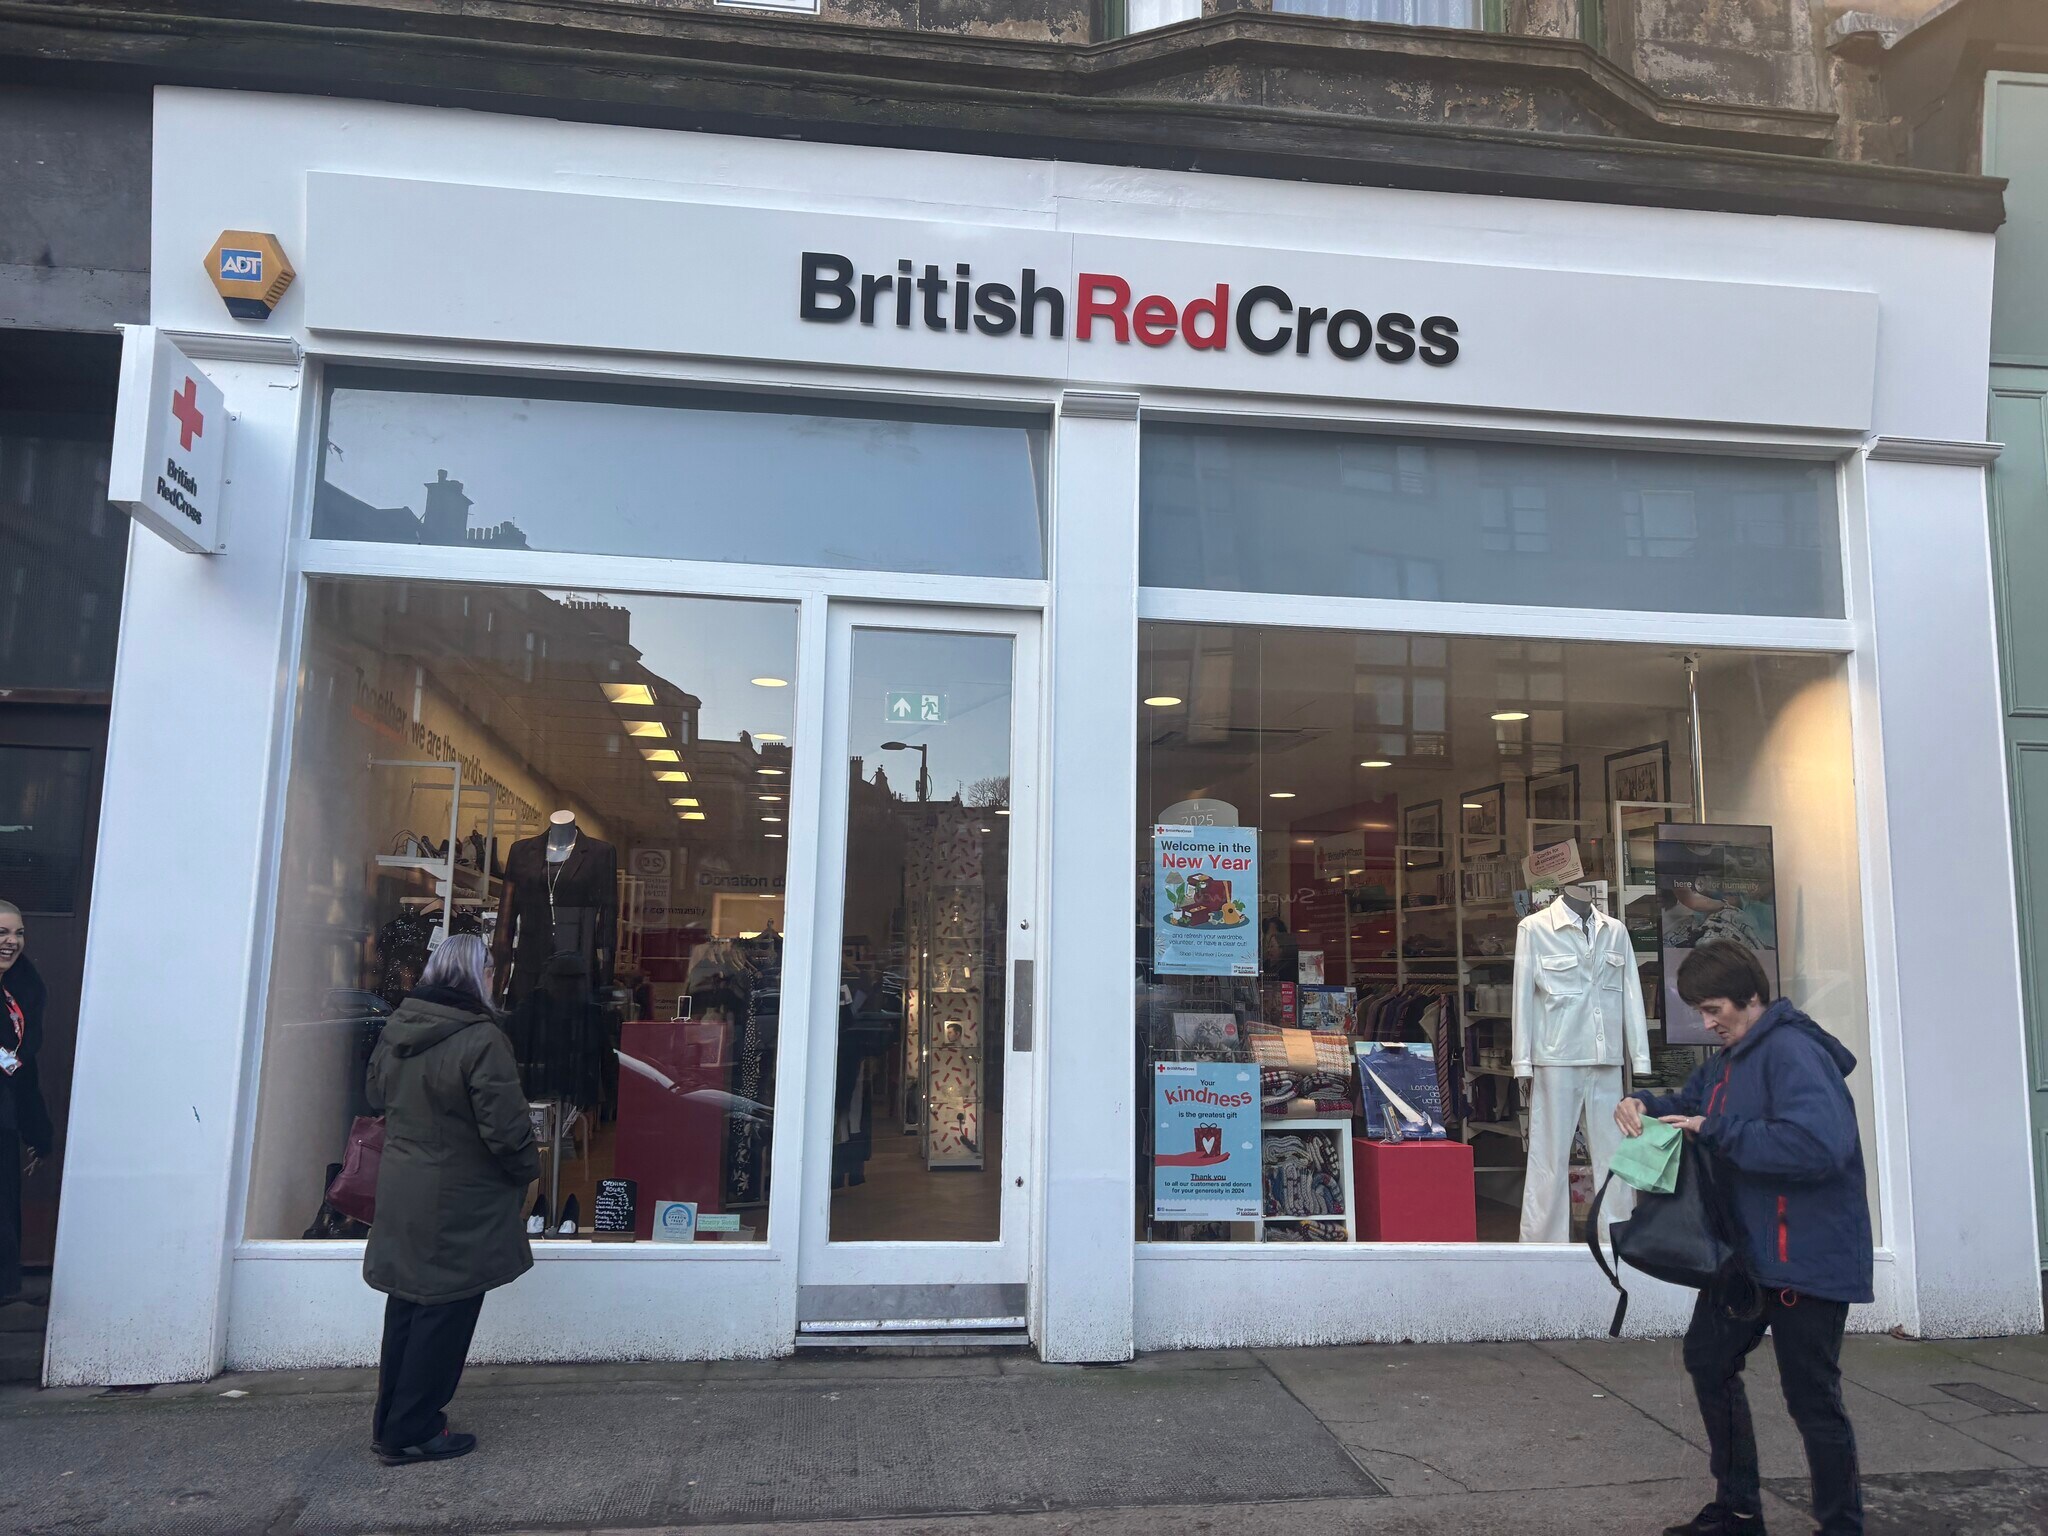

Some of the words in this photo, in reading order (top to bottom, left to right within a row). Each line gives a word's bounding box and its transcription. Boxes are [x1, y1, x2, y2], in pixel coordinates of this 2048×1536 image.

[221, 255, 262, 275] ADT
[800, 252, 1459, 365] BritishRedCross
[167, 457, 198, 497] British
[157, 475, 202, 525] RedCross
[412, 721, 426, 751] we
[427, 730, 441, 761] are
[443, 735, 457, 762] the
[1161, 841, 1215, 852] Welcome
[1218, 843, 1229, 853] in
[1233, 843, 1251, 853] the
[1162, 853, 1203, 869] New
[1208, 855, 1252, 871] Year
[700, 873, 768, 888] Donation
[1673, 879, 1692, 888] here
[1709, 879, 1720, 889] for
[1722, 881, 1759, 891] humanity
[1164, 1085, 1253, 1107] kindness
